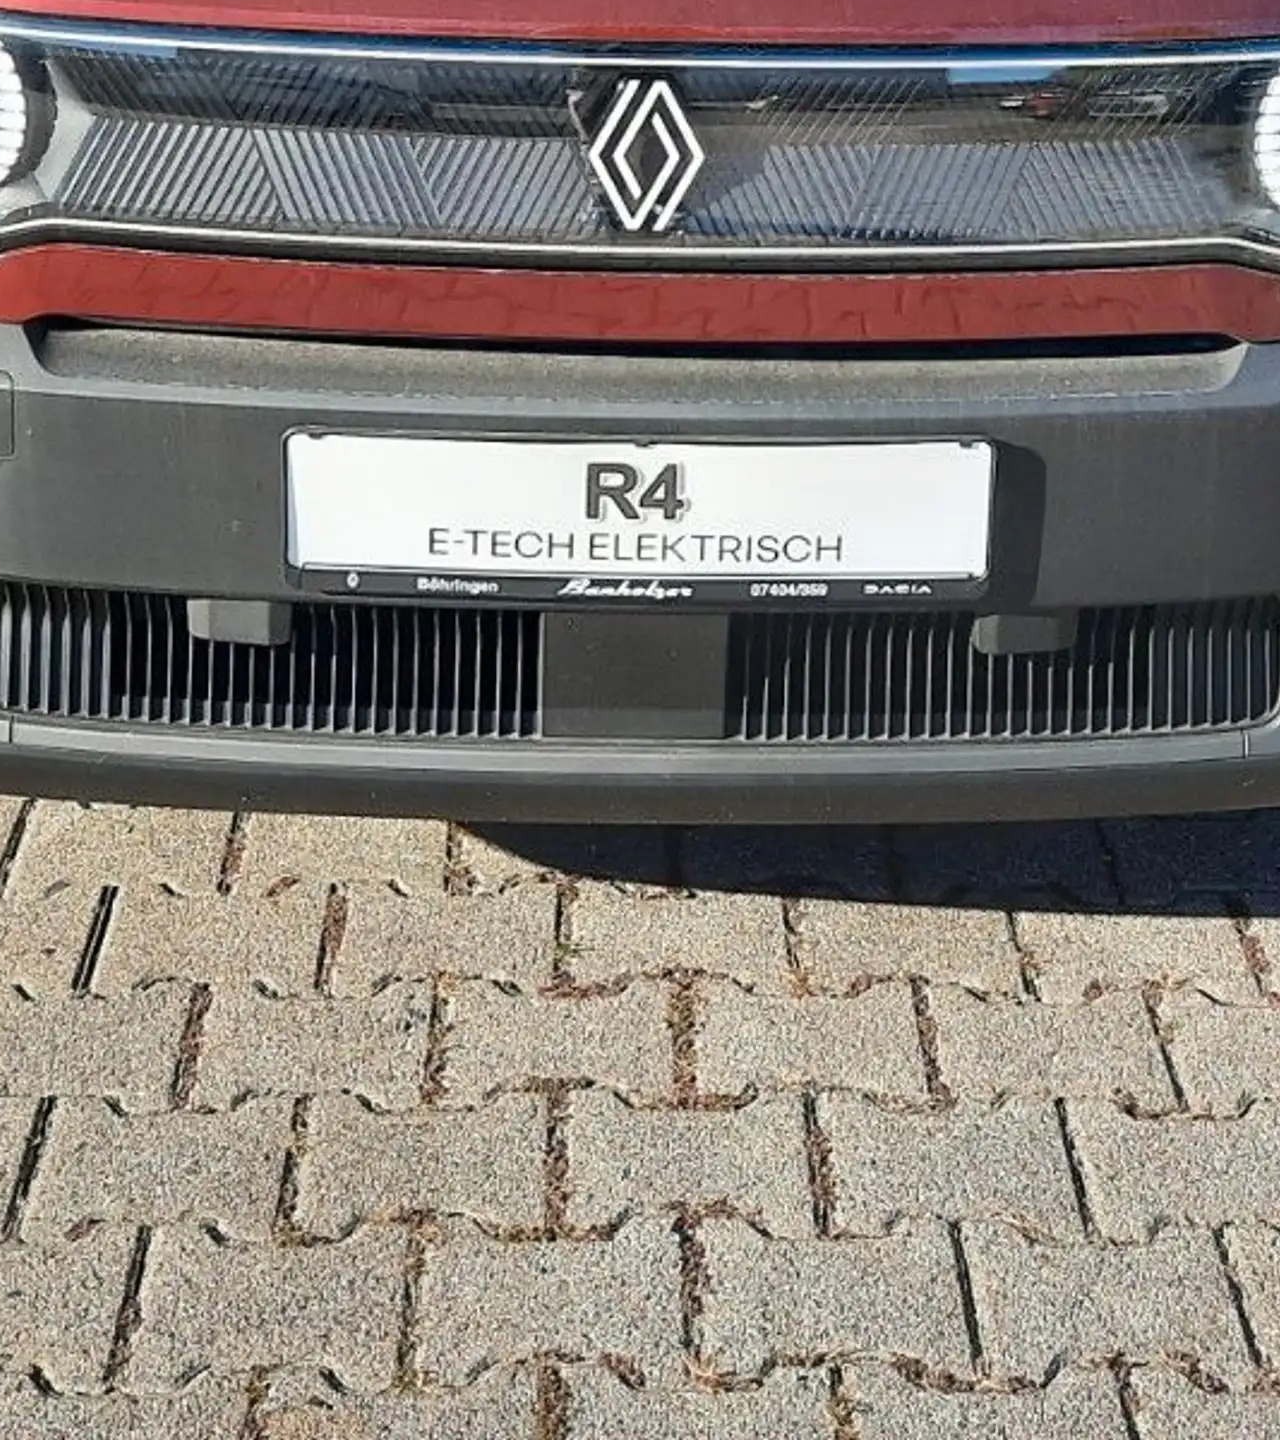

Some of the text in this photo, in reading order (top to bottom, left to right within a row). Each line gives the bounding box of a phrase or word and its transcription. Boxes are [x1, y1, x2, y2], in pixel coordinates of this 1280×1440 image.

[585, 462, 685, 520] R4
[428, 528, 842, 563] E-TECH ELEKTRISCH
[417, 577, 499, 595] Böhringen
[863, 583, 932, 594] DACIA
